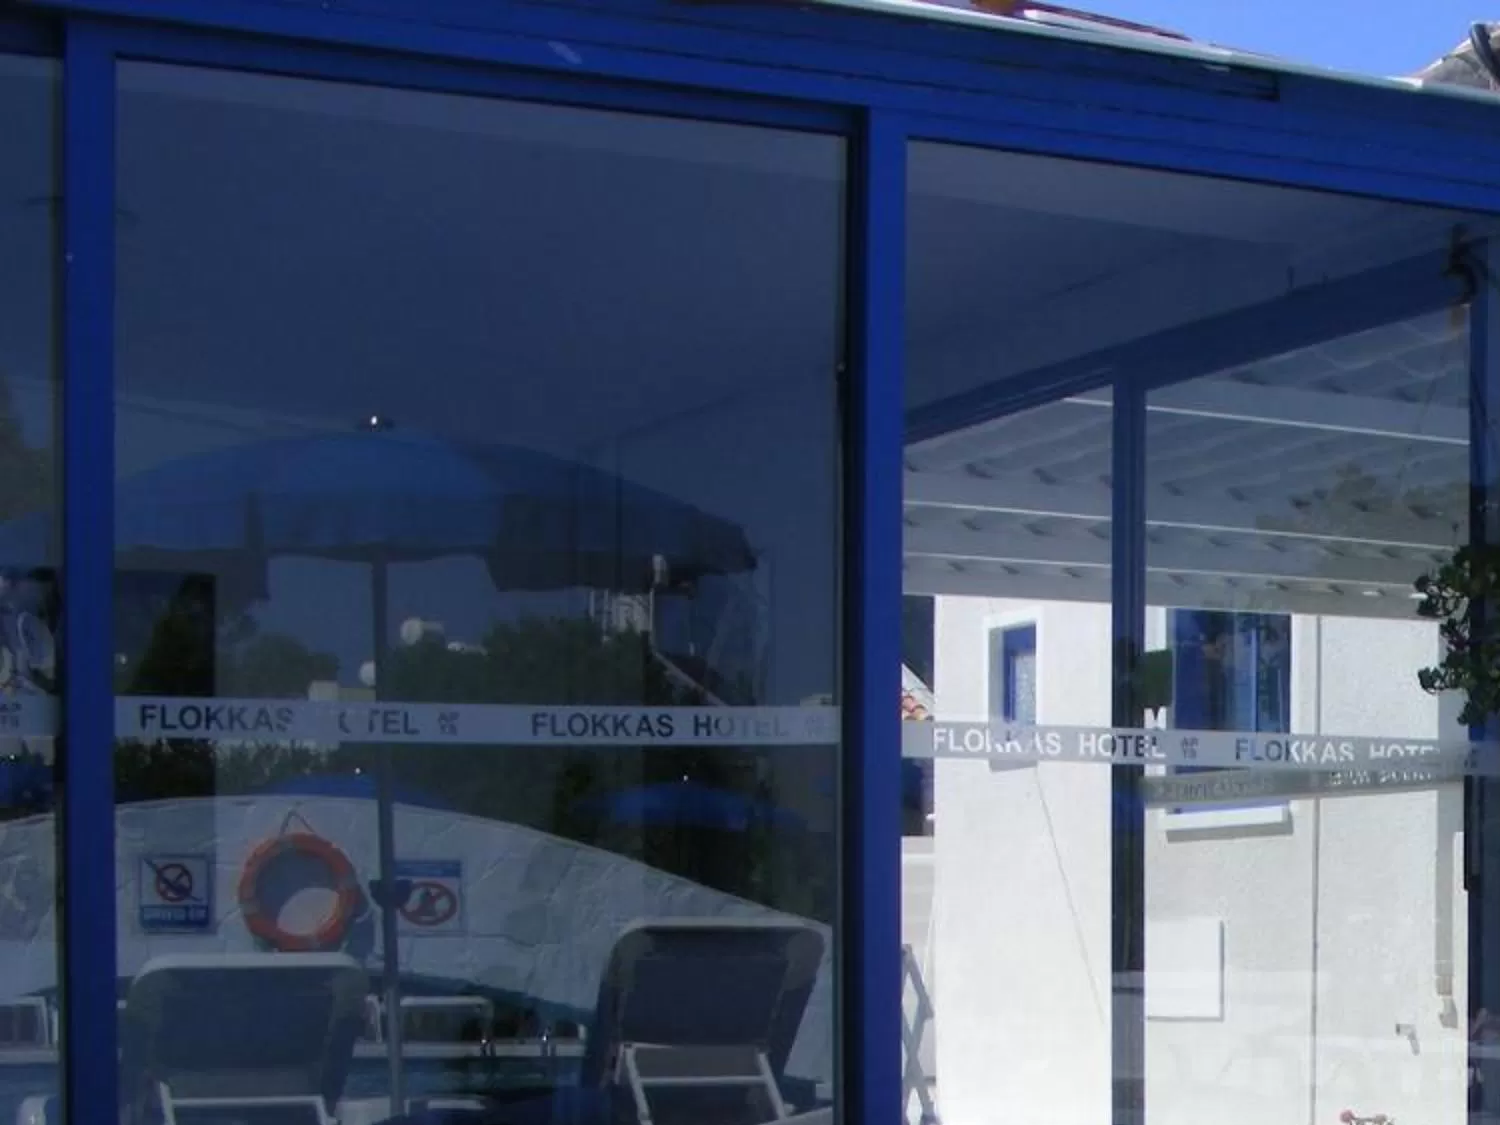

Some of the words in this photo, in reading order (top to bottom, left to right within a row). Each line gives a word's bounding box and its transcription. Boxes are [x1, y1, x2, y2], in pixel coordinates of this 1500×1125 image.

[140, 704, 293, 733] FLOKKAS
[532, 713, 674, 738] FLOKKAS
[694, 715, 790, 738] HOTEL
[1078, 733, 1167, 759] HOTEL
[1236, 738, 1354, 765] FLOKKAS
[1368, 742, 1441, 762] HOTE
